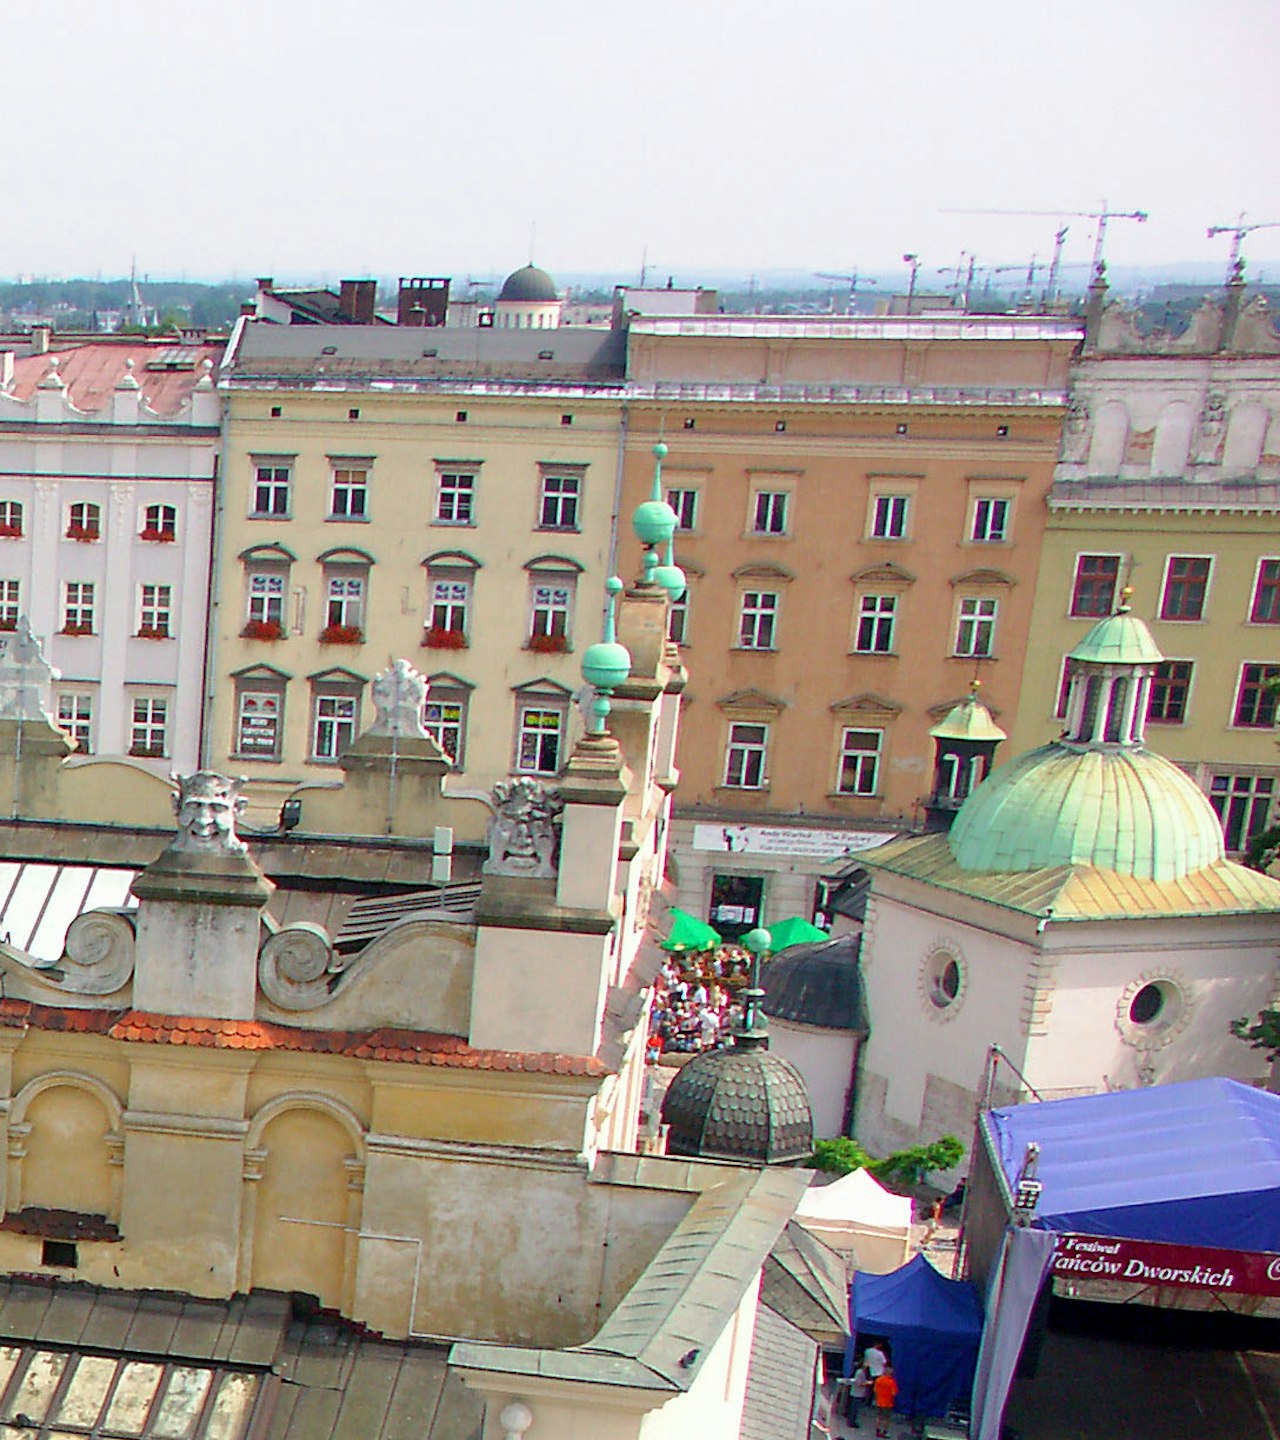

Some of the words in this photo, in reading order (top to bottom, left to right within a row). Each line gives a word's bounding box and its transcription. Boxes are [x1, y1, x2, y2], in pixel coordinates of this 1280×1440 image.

[1066, 1238, 1121, 1255] Festiwal
[1050, 1252, 1122, 1273] Tańców
[1123, 1259, 1234, 1287] Dworskich
